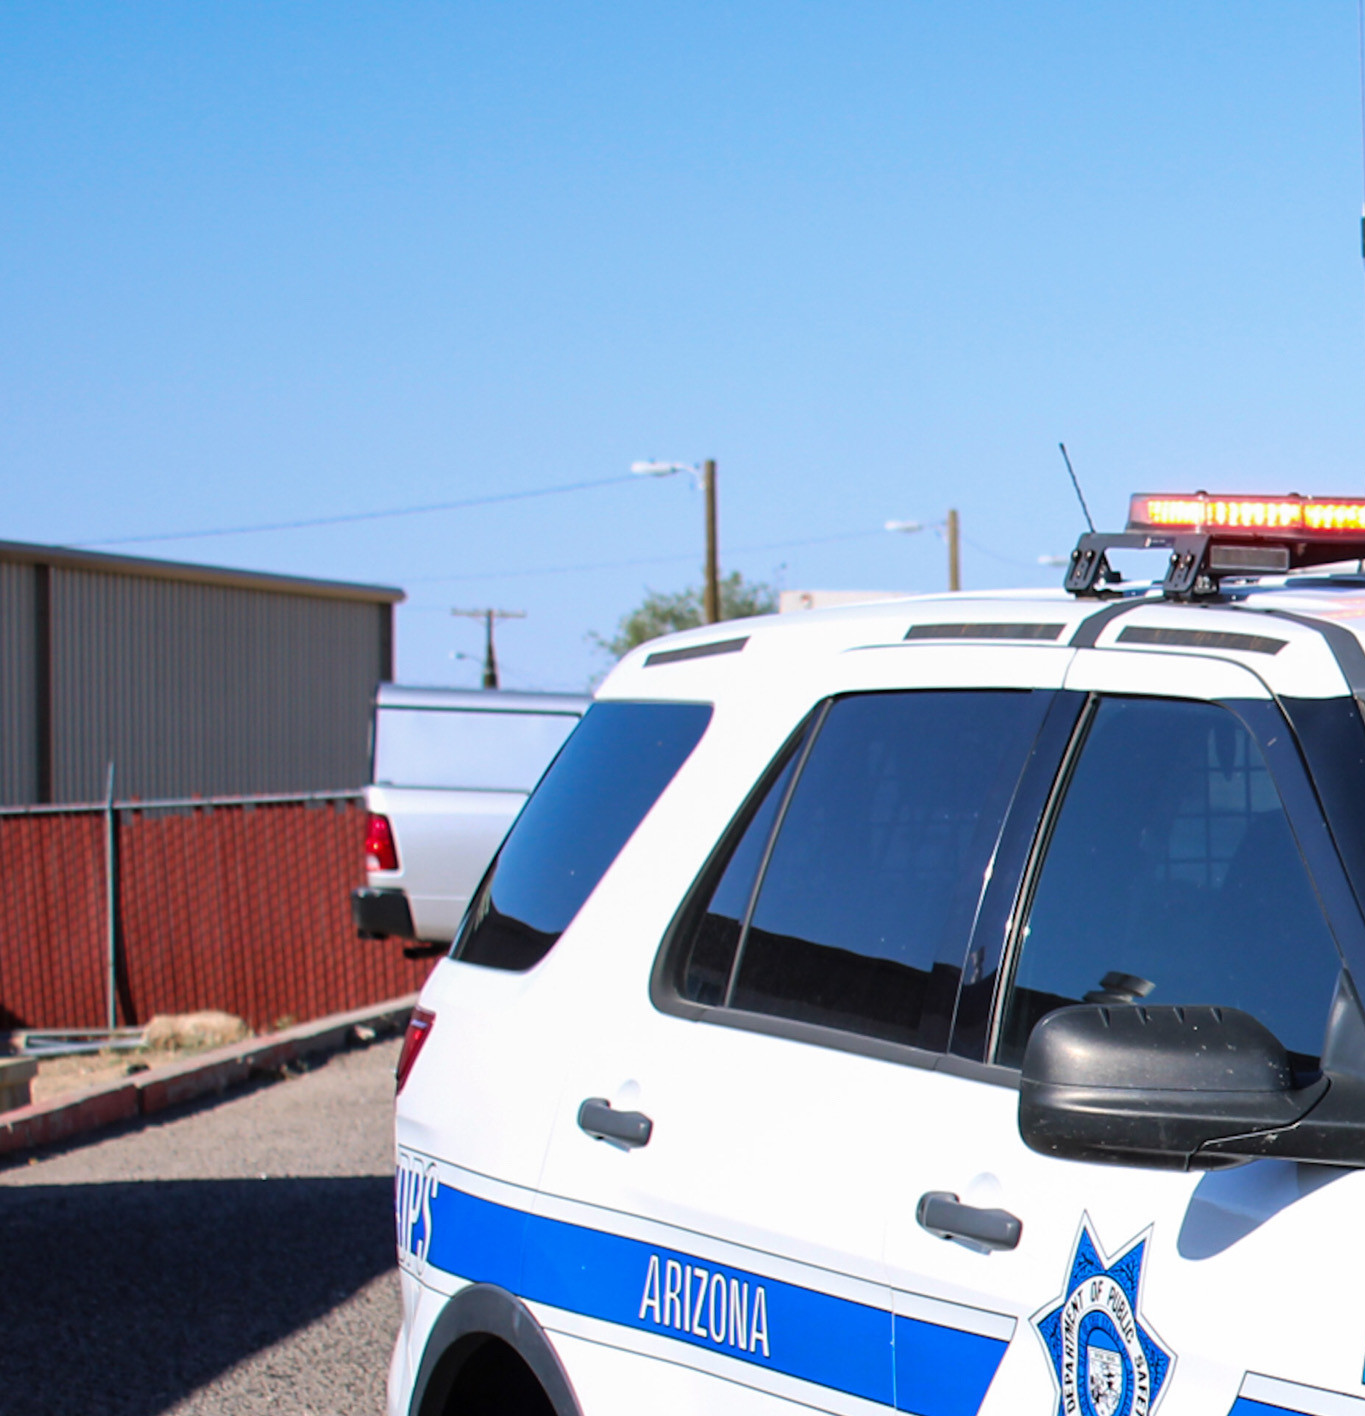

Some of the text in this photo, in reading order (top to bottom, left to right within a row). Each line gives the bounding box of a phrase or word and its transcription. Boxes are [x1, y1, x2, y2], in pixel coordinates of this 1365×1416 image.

[638, 1254, 770, 1358] ARIZONA
[1064, 1289, 1084, 1415] DEPARTMENT
[1090, 1280, 1104, 1302] OF
[1107, 1286, 1134, 1344] PUBLIC
